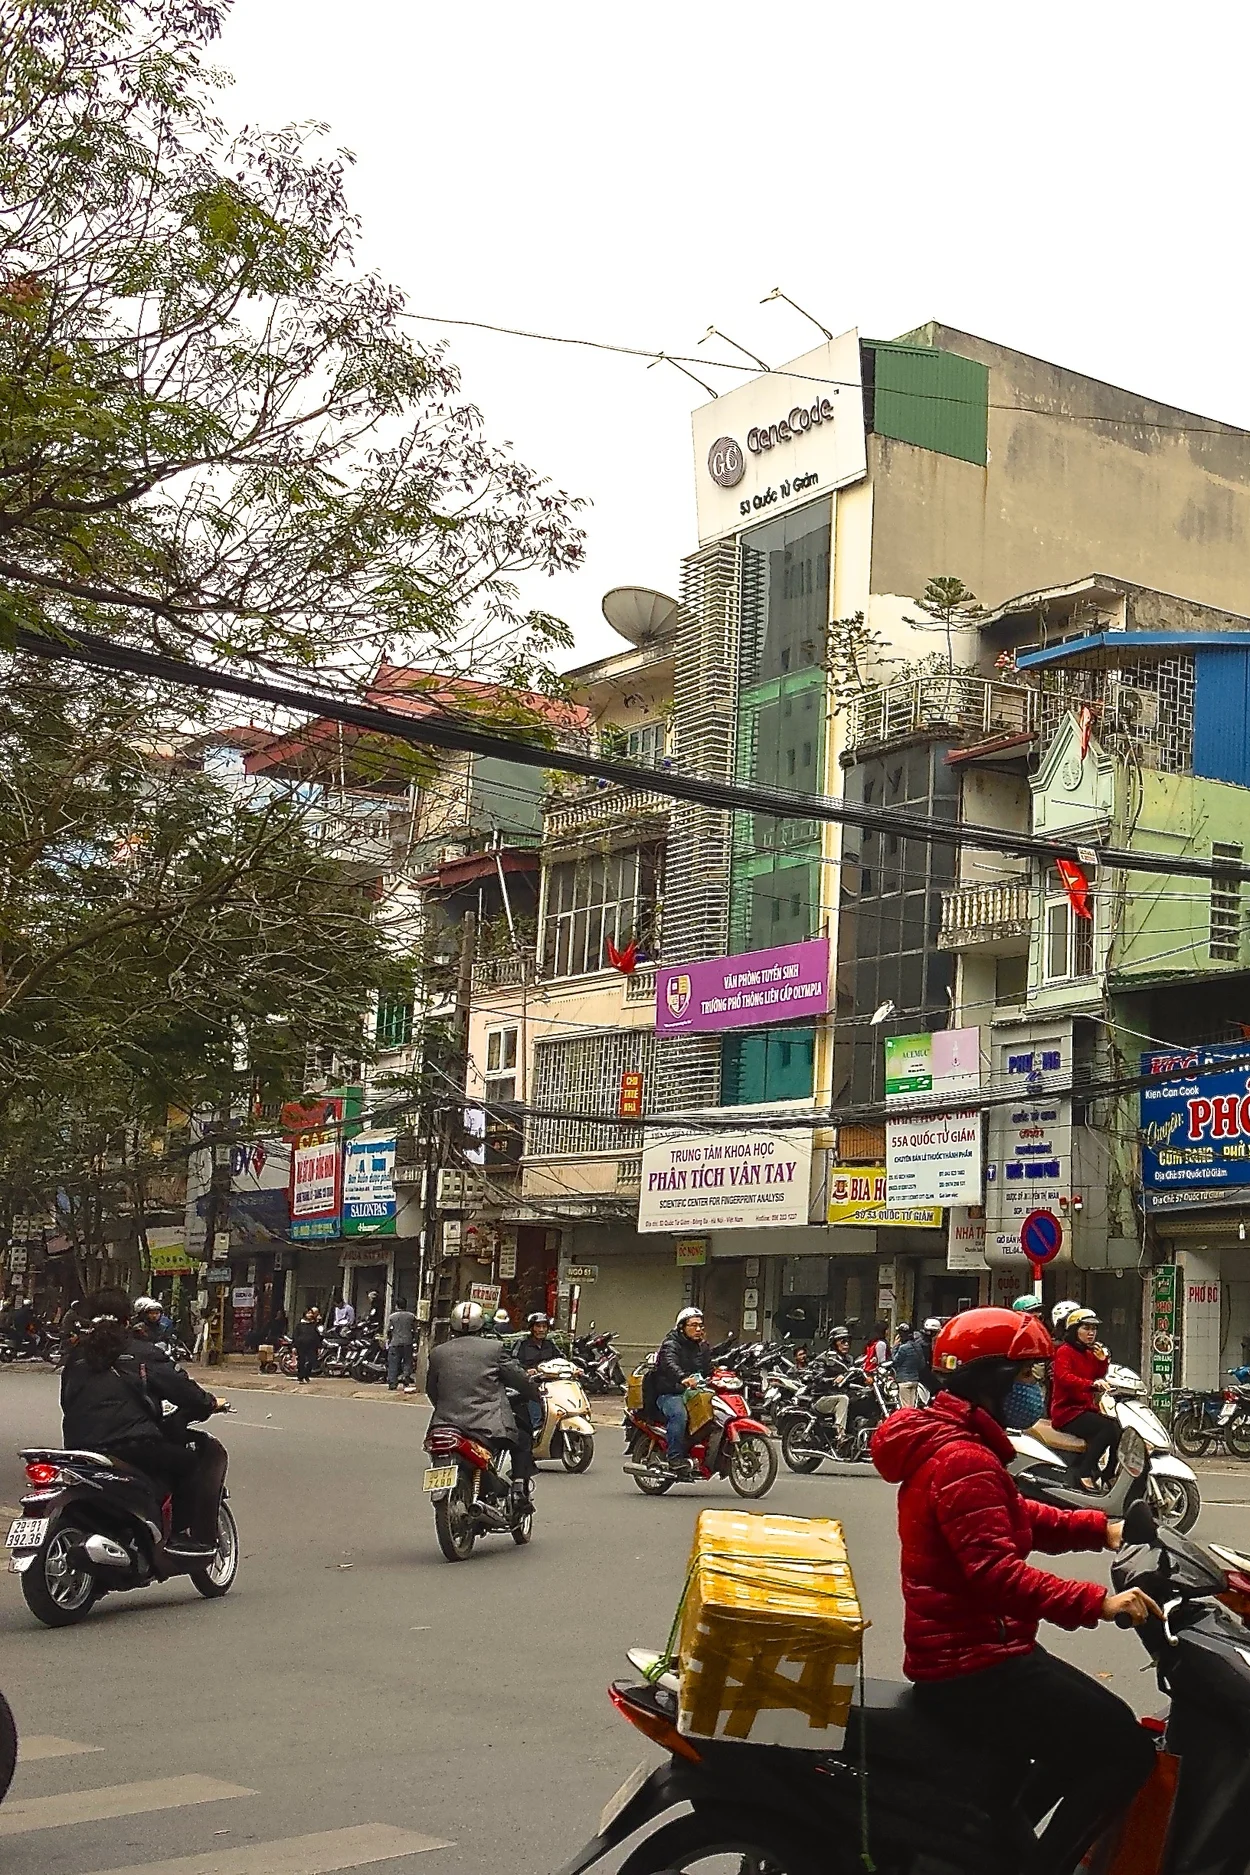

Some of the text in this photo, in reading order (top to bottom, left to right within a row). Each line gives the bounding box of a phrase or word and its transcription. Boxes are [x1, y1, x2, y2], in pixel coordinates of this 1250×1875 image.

[747, 397, 834, 455] GeneCode
[753, 487, 778, 511] Quốc
[793, 471, 818, 493] Giám
[738, 968, 762, 988] PHÒNG
[782, 964, 800, 981] SINH
[740, 990, 765, 1010] THÔNG
[793, 982, 823, 1000] OLYMPIA
[1162, 1087, 1178, 1098] Can
[1179, 1085, 1200, 1096] Cook
[892, 1135, 909, 1148] 55A
[909, 1130, 936, 1148] QUỐC
[951, 1127, 976, 1143] GIÁM
[671, 1141, 775, 1163] TRUNG TÂM KHOA HỌC
[648, 1161, 798, 1191] PHÂN TÍCH VÂN TAY
[659, 1192, 785, 1209] SCIENTIFIC CENTER FOR FINGERPRINT ANALYSIS
[850, 1178, 871, 1201] BIA
[350, 1203, 388, 1217] SALONPAS
[955, 1226, 976, 1240] NHÀ
[7, 1533, 41, 1546] 392.36
